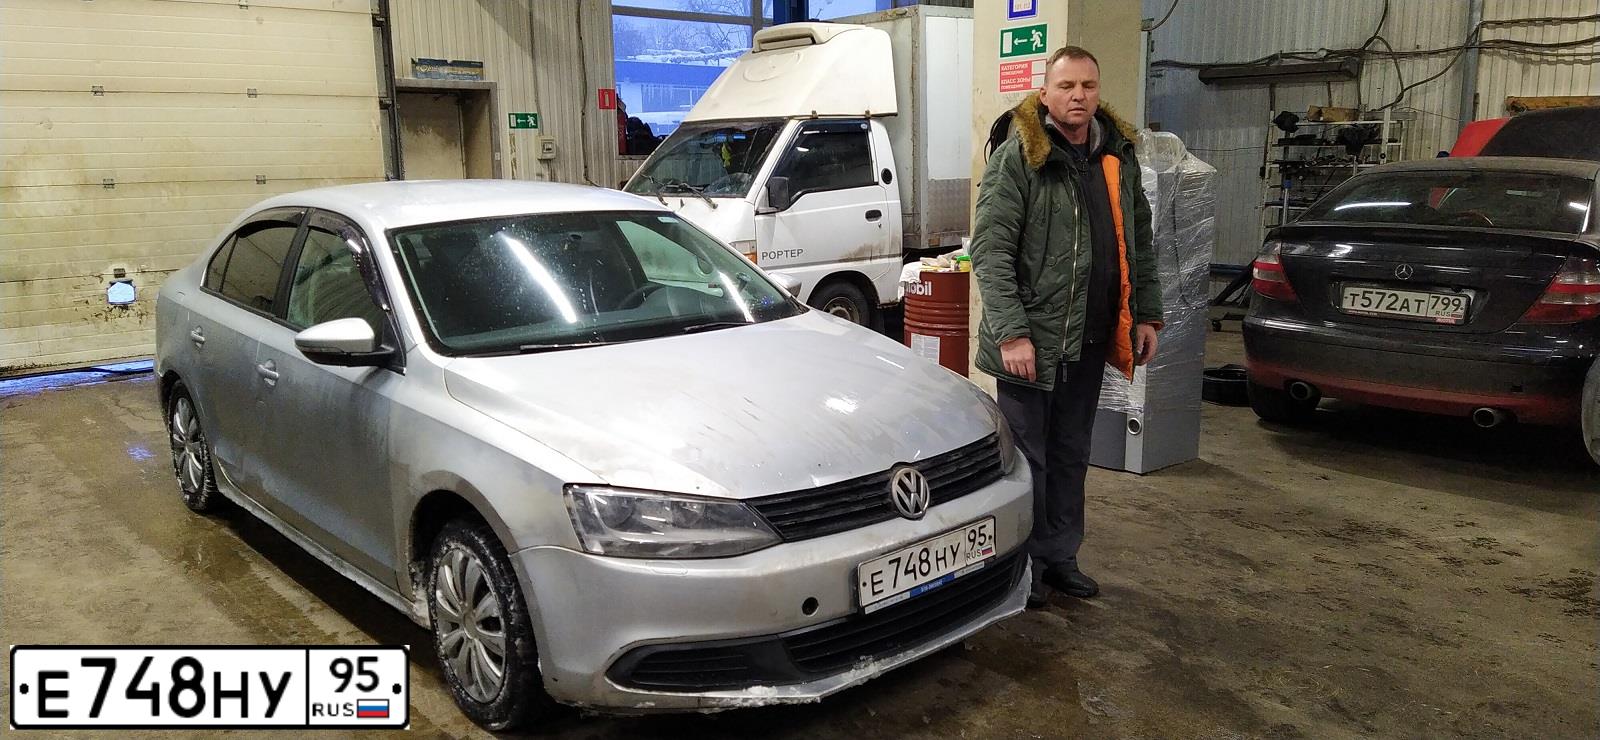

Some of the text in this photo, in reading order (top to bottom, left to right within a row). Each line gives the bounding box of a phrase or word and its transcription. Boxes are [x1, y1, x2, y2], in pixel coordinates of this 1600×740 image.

[1431, 295, 1461, 312] 799
[967, 525, 987, 550] 95
[966, 549, 982, 561] RUS
